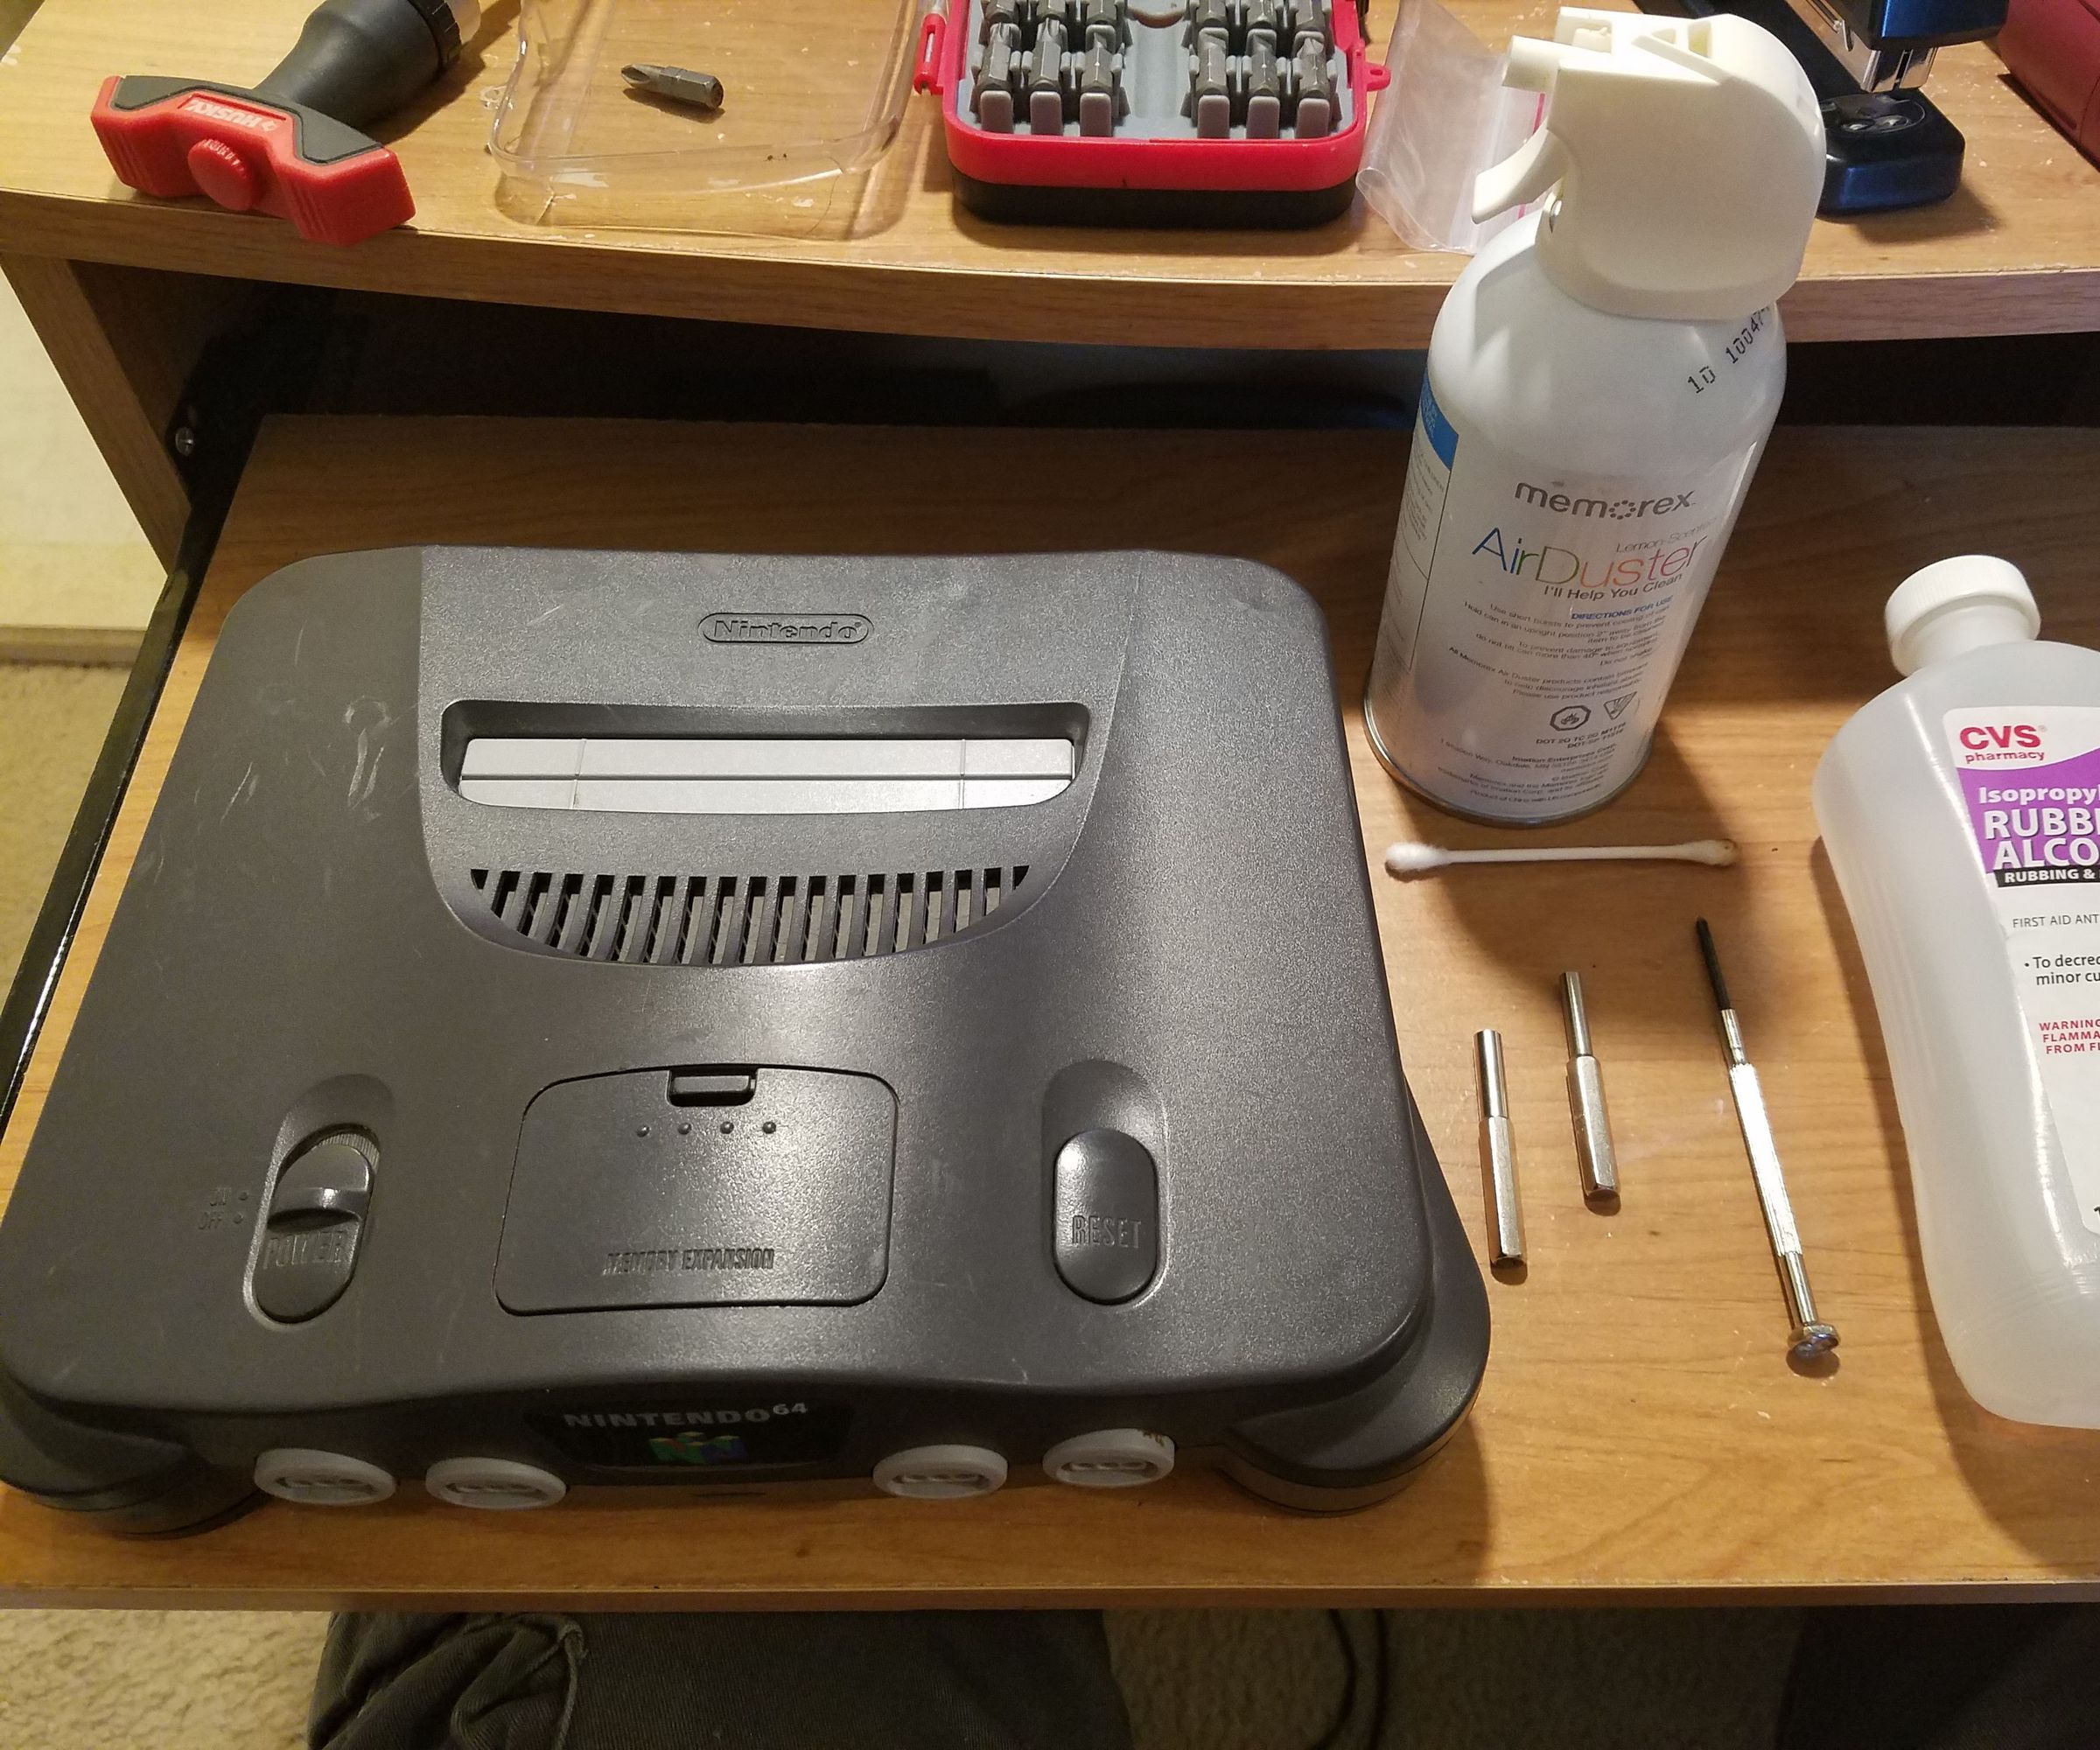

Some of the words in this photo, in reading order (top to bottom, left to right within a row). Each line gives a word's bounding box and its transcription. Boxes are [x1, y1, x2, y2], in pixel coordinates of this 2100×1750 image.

[183, 100, 262, 128] HUSKY
[1514, 481, 1696, 521] memorex
[1544, 584, 1564, 598] I'll
[1567, 589, 1605, 602] Help
[1610, 587, 1639, 599] You
[1642, 573, 1683, 593] Clean
[1464, 600, 1482, 616] Hold
[1571, 608, 1633, 620] DIRECTIONS
[1634, 603, 1655, 614] FOR
[713, 620, 858, 640] Nintendo
[1959, 724, 2042, 751] CVS
[1964, 750, 2046, 765] pharmacy
[1992, 836, 2100, 870] ALCO
[2004, 868, 2080, 884] RUBBING
[2082, 868, 2096, 879] &
[2012, 916, 2046, 928] FIRST
[2050, 914, 2072, 926] AID
[2075, 914, 2100, 925] ANT
[2032, 956, 2051, 969] To
[2036, 971, 2082, 985] minor
[2046, 1042, 2085, 1054] FROM
[1072, 1214, 1142, 1250] RESET
[681, 1248, 775, 1270] EXPANSION
[564, 1408, 771, 1428] NINTENDO
[772, 1402, 808, 1416] 64
